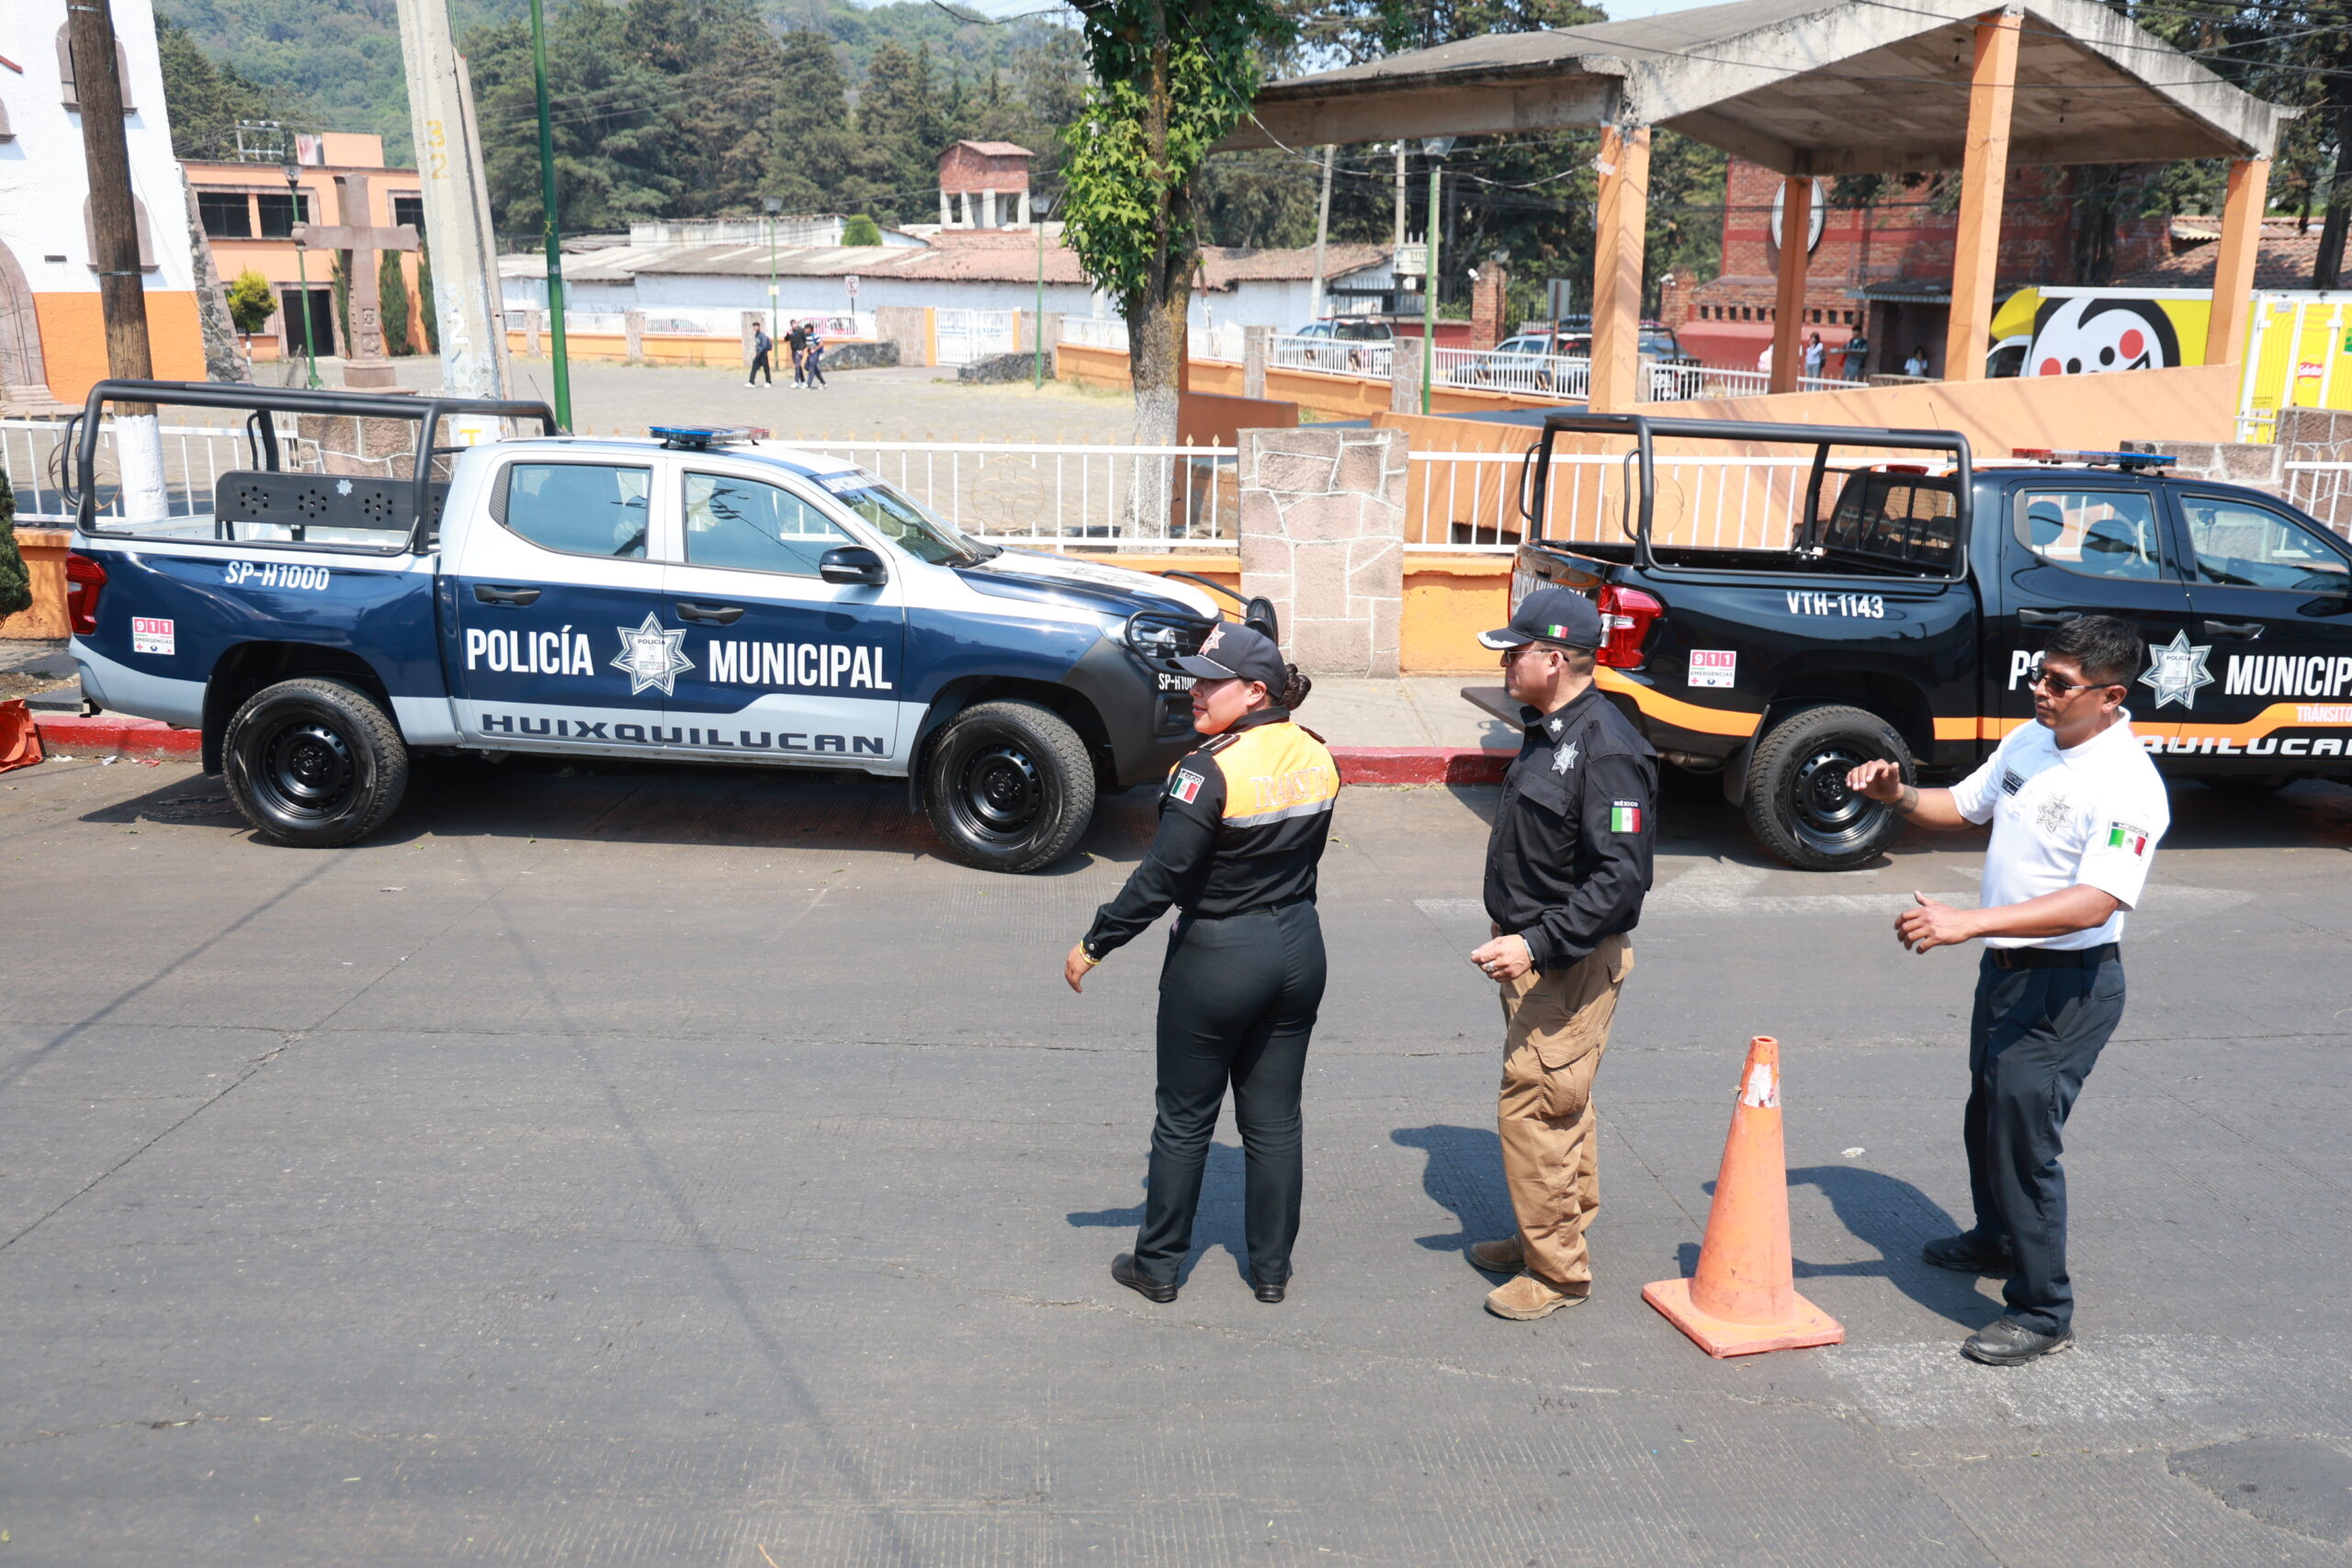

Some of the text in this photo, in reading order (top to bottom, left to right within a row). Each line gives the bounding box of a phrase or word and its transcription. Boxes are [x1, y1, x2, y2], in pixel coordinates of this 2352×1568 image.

[224, 560, 330, 591] SP-H1000
[1786, 591, 1884, 618] VTH-1143
[136, 620, 169, 633] 911
[134, 637, 173, 645] EMERGENCIAS
[467, 624, 893, 690] POLICÍA MUNICIPAL
[1694, 653, 1731, 666] 911
[2224, 654, 2352, 696] MUNICIP
[481, 713, 884, 755] HUIXQUILUCAN
[2136, 735, 2352, 755] QUILUCA
[1613, 799, 1639, 807] MÉXICO
